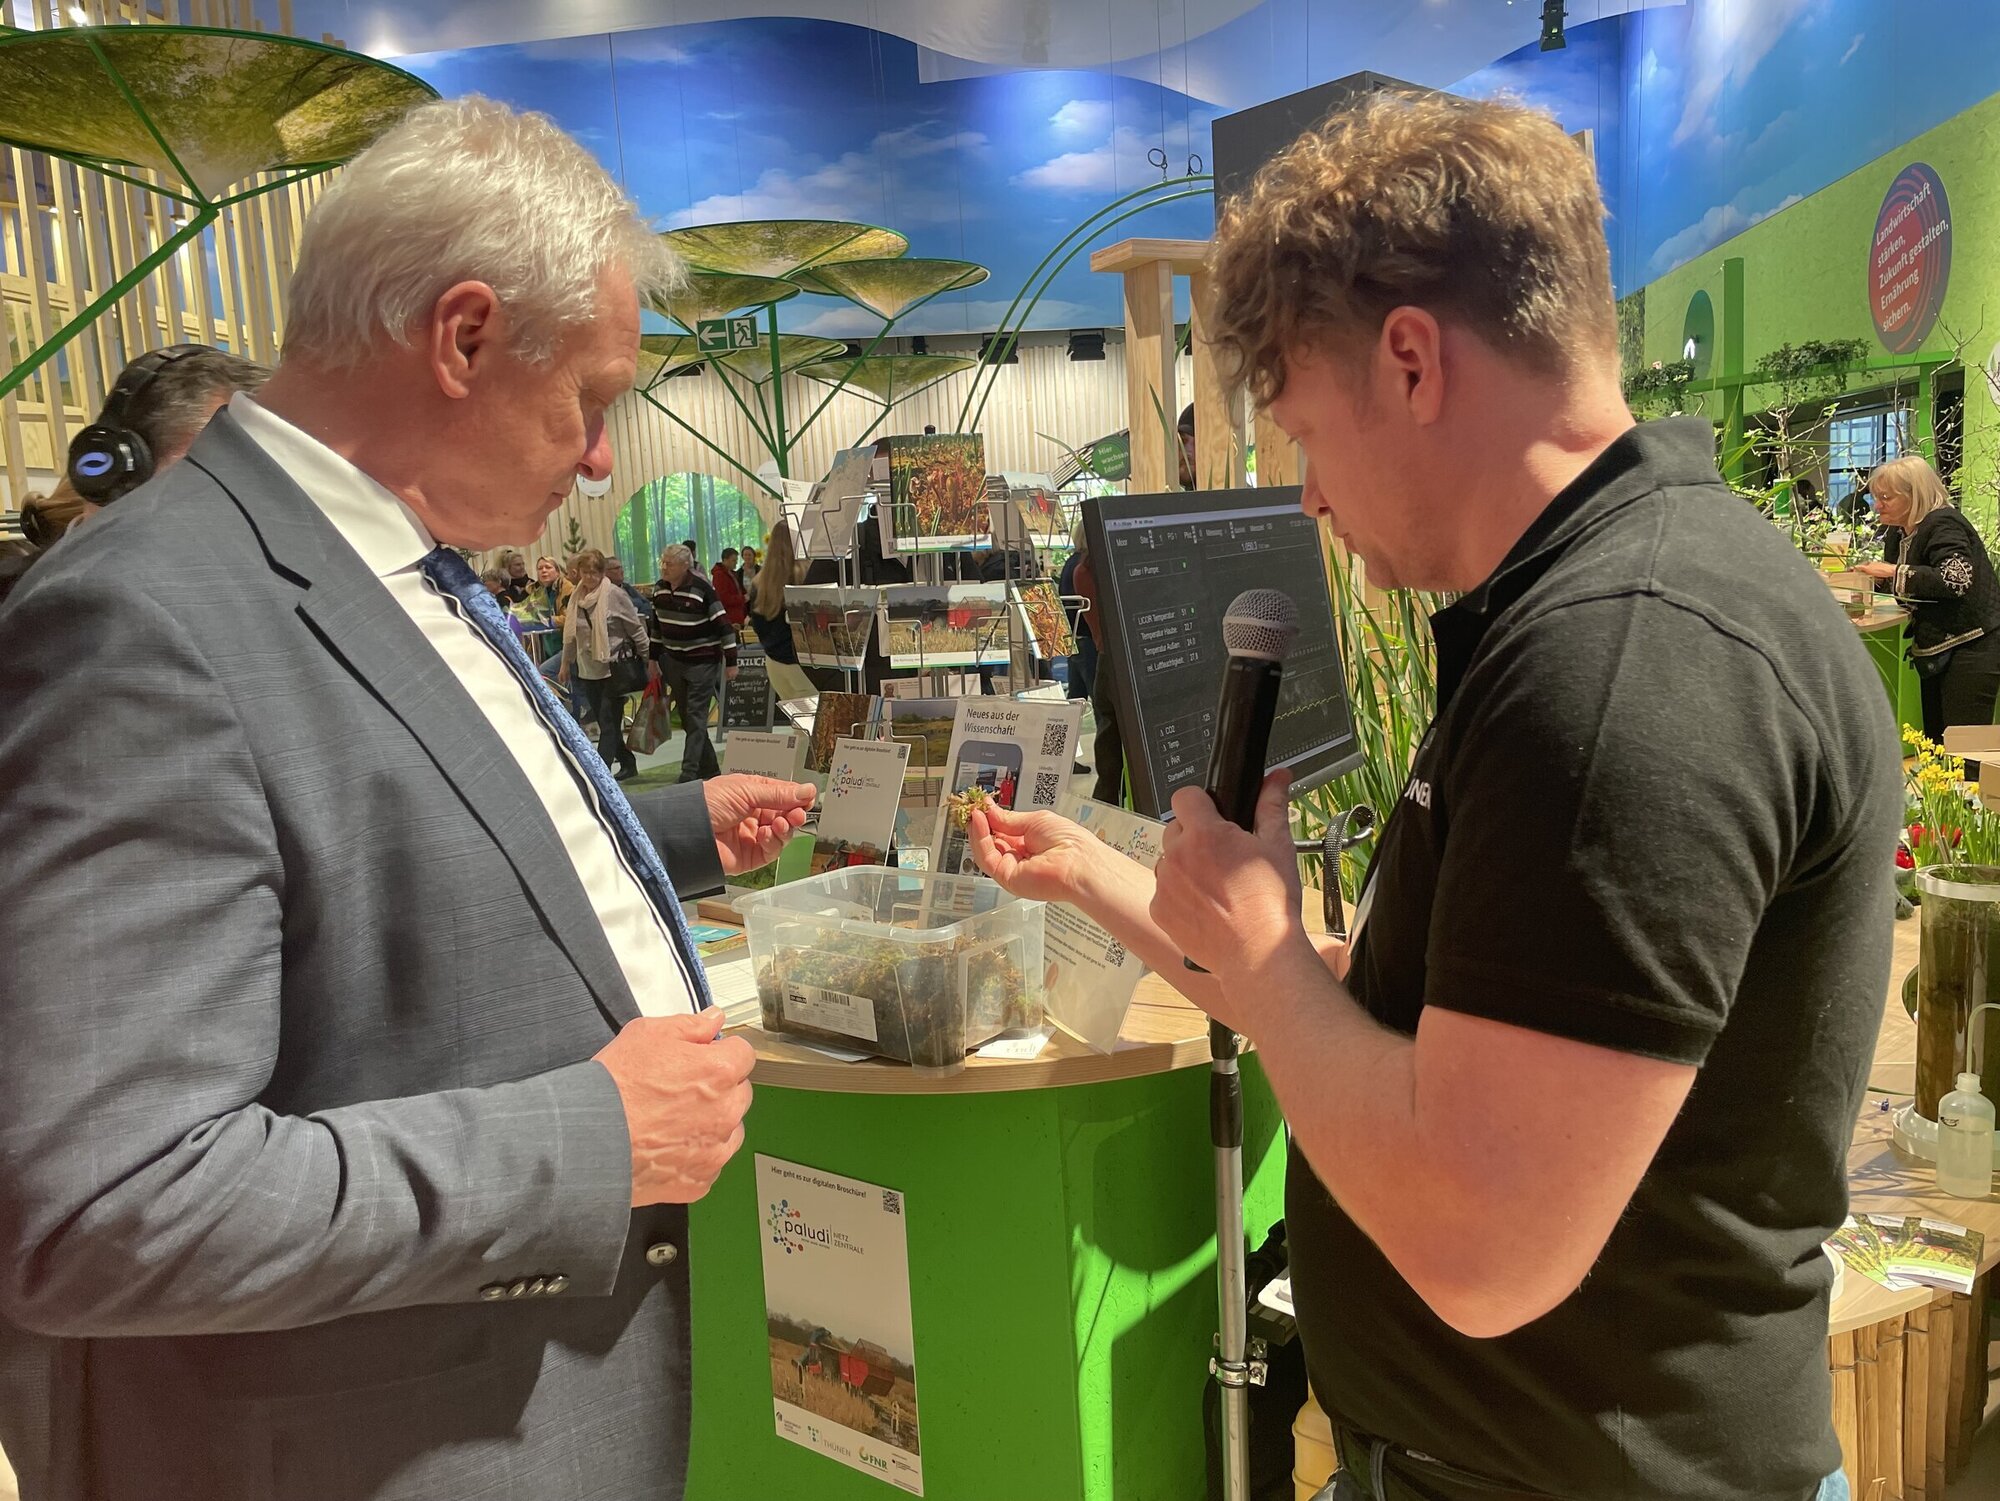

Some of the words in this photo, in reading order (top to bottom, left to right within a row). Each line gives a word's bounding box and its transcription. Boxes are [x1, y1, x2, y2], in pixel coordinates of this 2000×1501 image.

[1876, 182, 1931, 247] Landwirtschaft
[1877, 233, 1906, 268] stärken,
[1878, 255, 1909, 289] Zukunft
[1908, 219, 1949, 264] gestalten,
[1880, 268, 1919, 310] Ernährung
[1882, 301, 1911, 333] sichern.
[1098, 447, 1112, 455] Hier
[1101, 451, 1128, 464] wachsen
[1140, 629, 1163, 641] Temperatur
[1144, 645, 1167, 656] Temperatur
[966, 708, 989, 720] Neues
[990, 711, 1004, 721] aus
[1005, 711, 1020, 721] der
[964, 722, 1016, 736] Wissenschaft!
[771, 1165, 782, 1175] Hier
[783, 1170, 795, 1179] geht
[812, 1177, 836, 1190] digitalen
[836, 1183, 867, 1198] Broschüre!
[784, 1220, 830, 1245] paludi
[833, 1232, 849, 1243] NETZ
[834, 1240, 864, 1255] ZENTRALE
[869, 1454, 888, 1470] FNR
